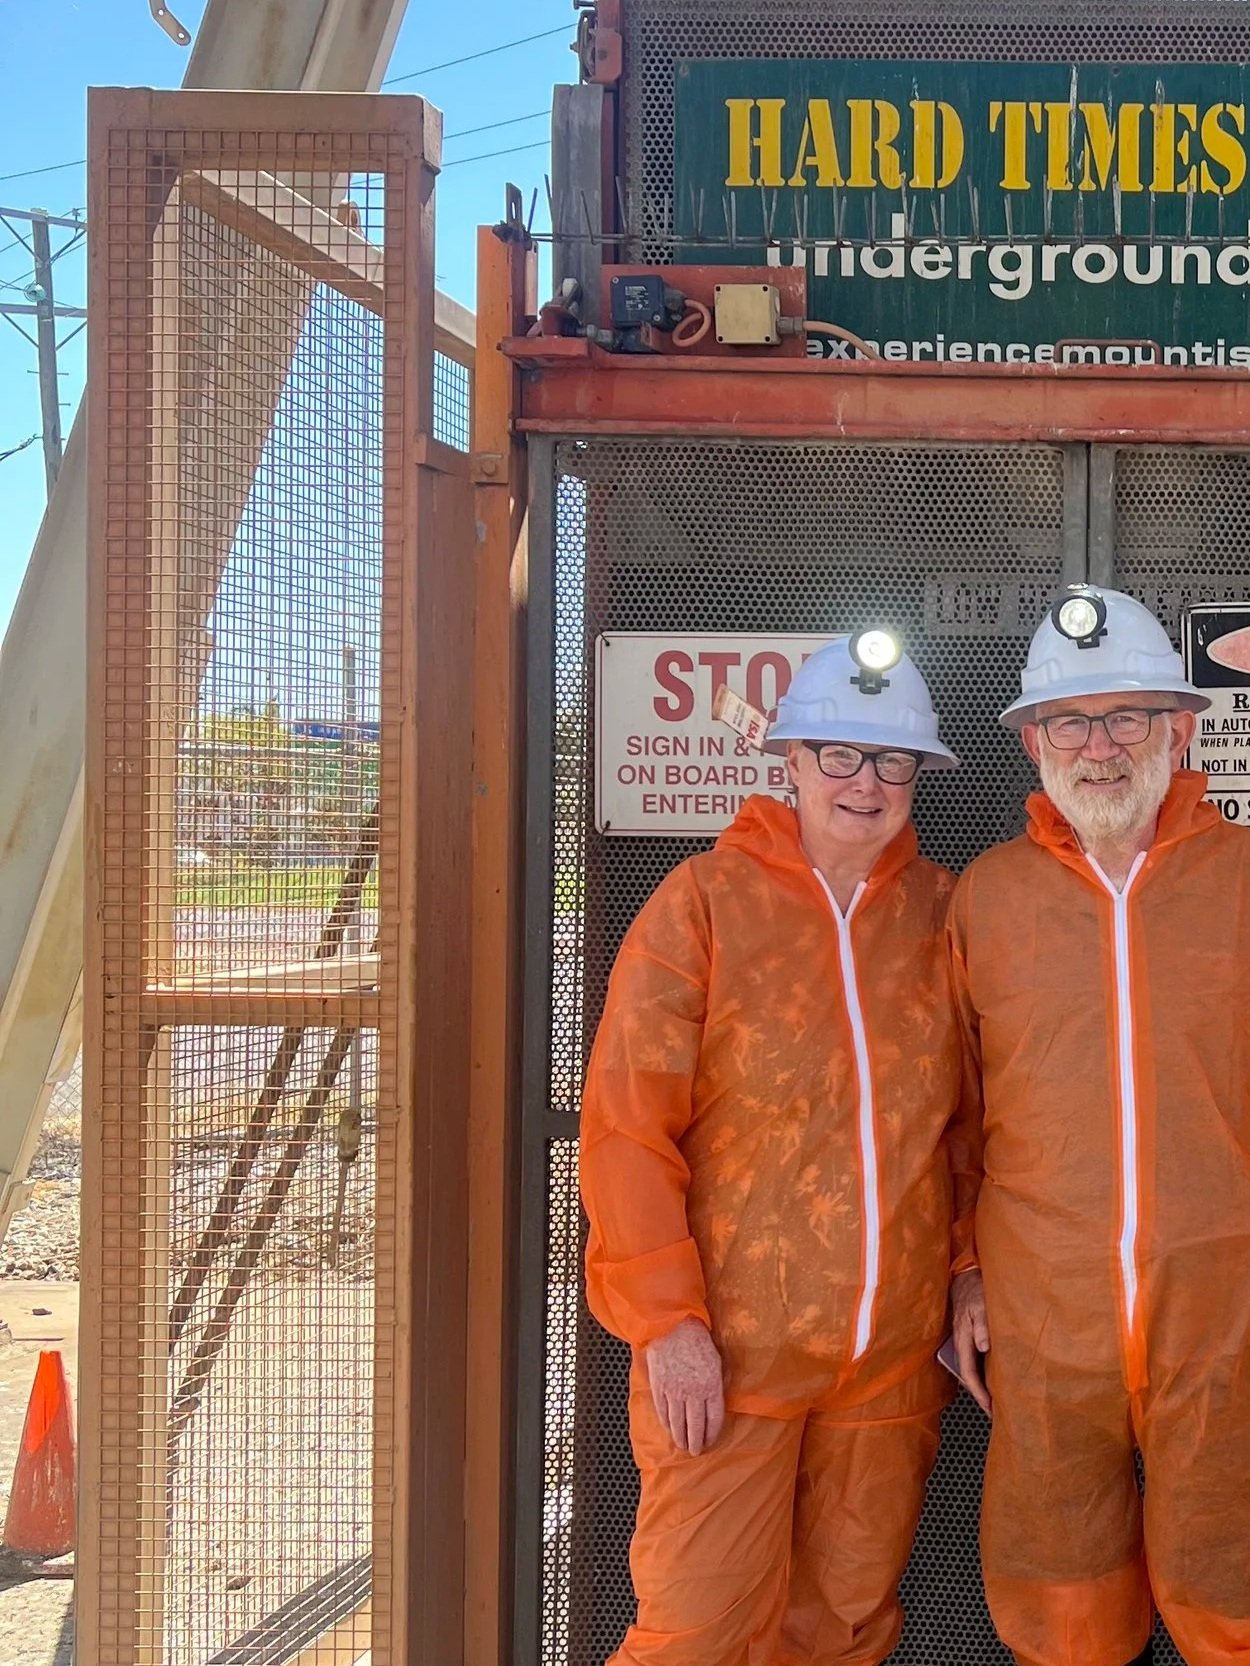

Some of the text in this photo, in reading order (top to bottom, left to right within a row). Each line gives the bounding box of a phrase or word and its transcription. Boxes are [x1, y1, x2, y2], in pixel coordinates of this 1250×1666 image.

[725, 98, 965, 190] HARD
[989, 101, 1247, 195] TIMES
[653, 650, 813, 722] STO
[1232, 693, 1249, 709] R
[1202, 719, 1215, 732] IN
[626, 736, 750, 757] SIGN IN &
[1200, 737, 1228, 748] WHEN
[1201, 759, 1228, 773] NOT
[1234, 759, 1247, 772] IN
[617, 765, 655, 785] ON
[665, 765, 758, 786] BOARD
